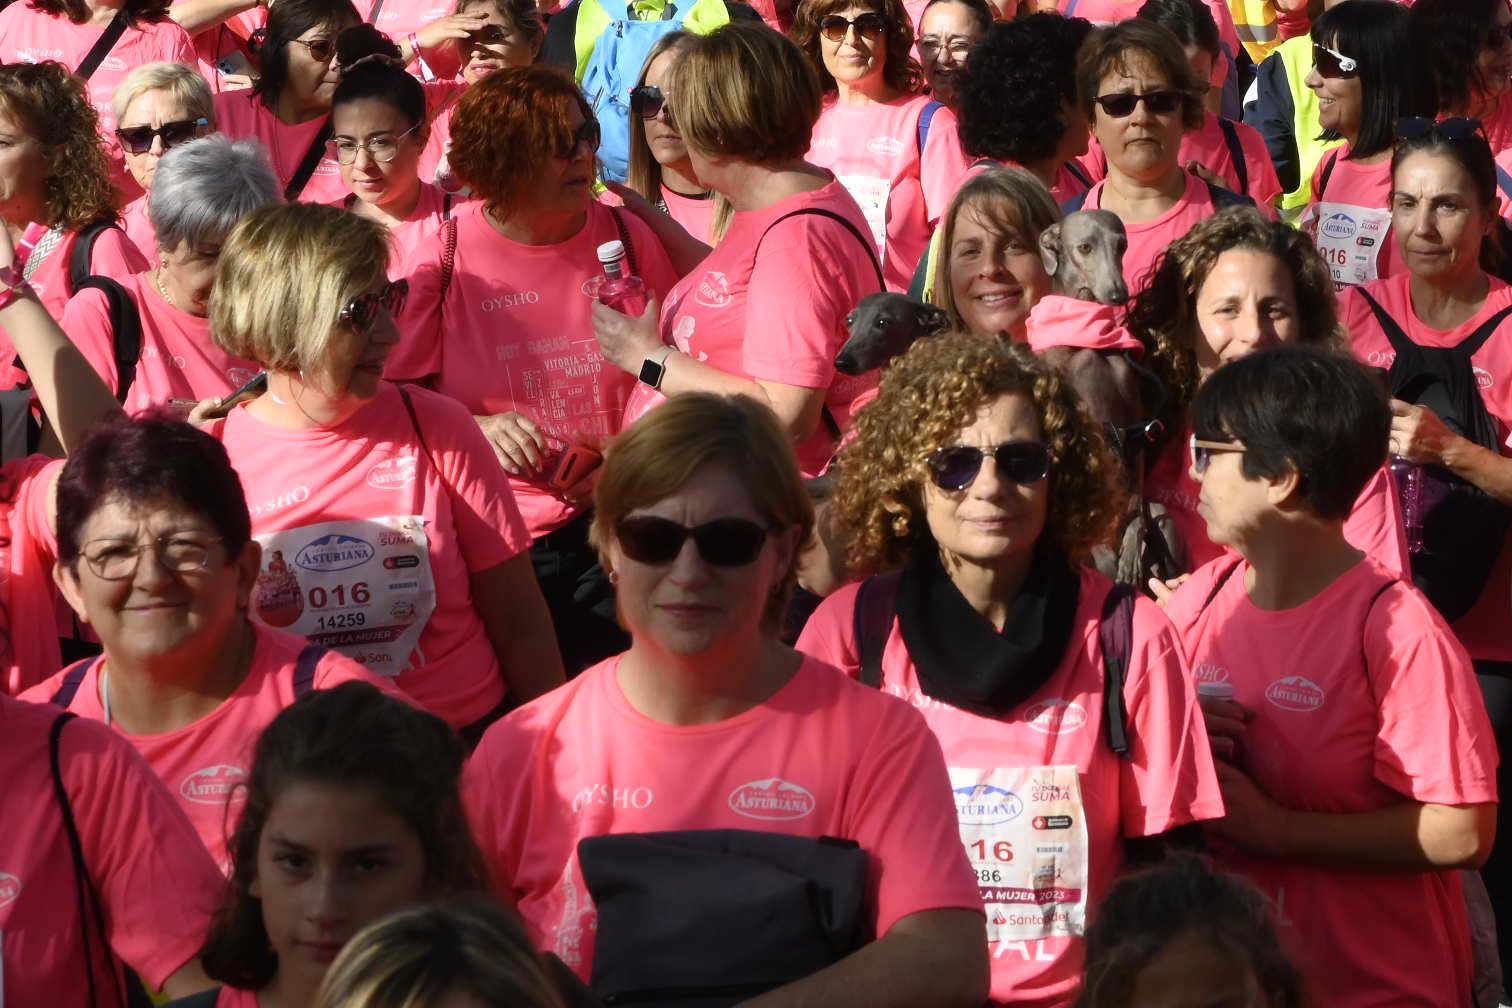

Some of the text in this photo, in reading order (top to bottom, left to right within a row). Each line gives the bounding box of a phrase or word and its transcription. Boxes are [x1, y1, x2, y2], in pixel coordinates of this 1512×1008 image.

[481, 291, 539, 313] OYSHO
[249, 486, 309, 514] YSHO
[302, 549, 370, 566] ASTURIANA
[309, 582, 371, 609] 016
[317, 612, 367, 631] 14259
[1196, 663, 1229, 683] SHO
[572, 783, 654, 814] OYSHO
[735, 792, 808, 812] ASTURIANA
[1032, 792, 1071, 802] SUMA
[956, 803, 1017, 816] TURIANA
[970, 839, 1015, 862] 16
[996, 890, 1036, 902] MUJER
